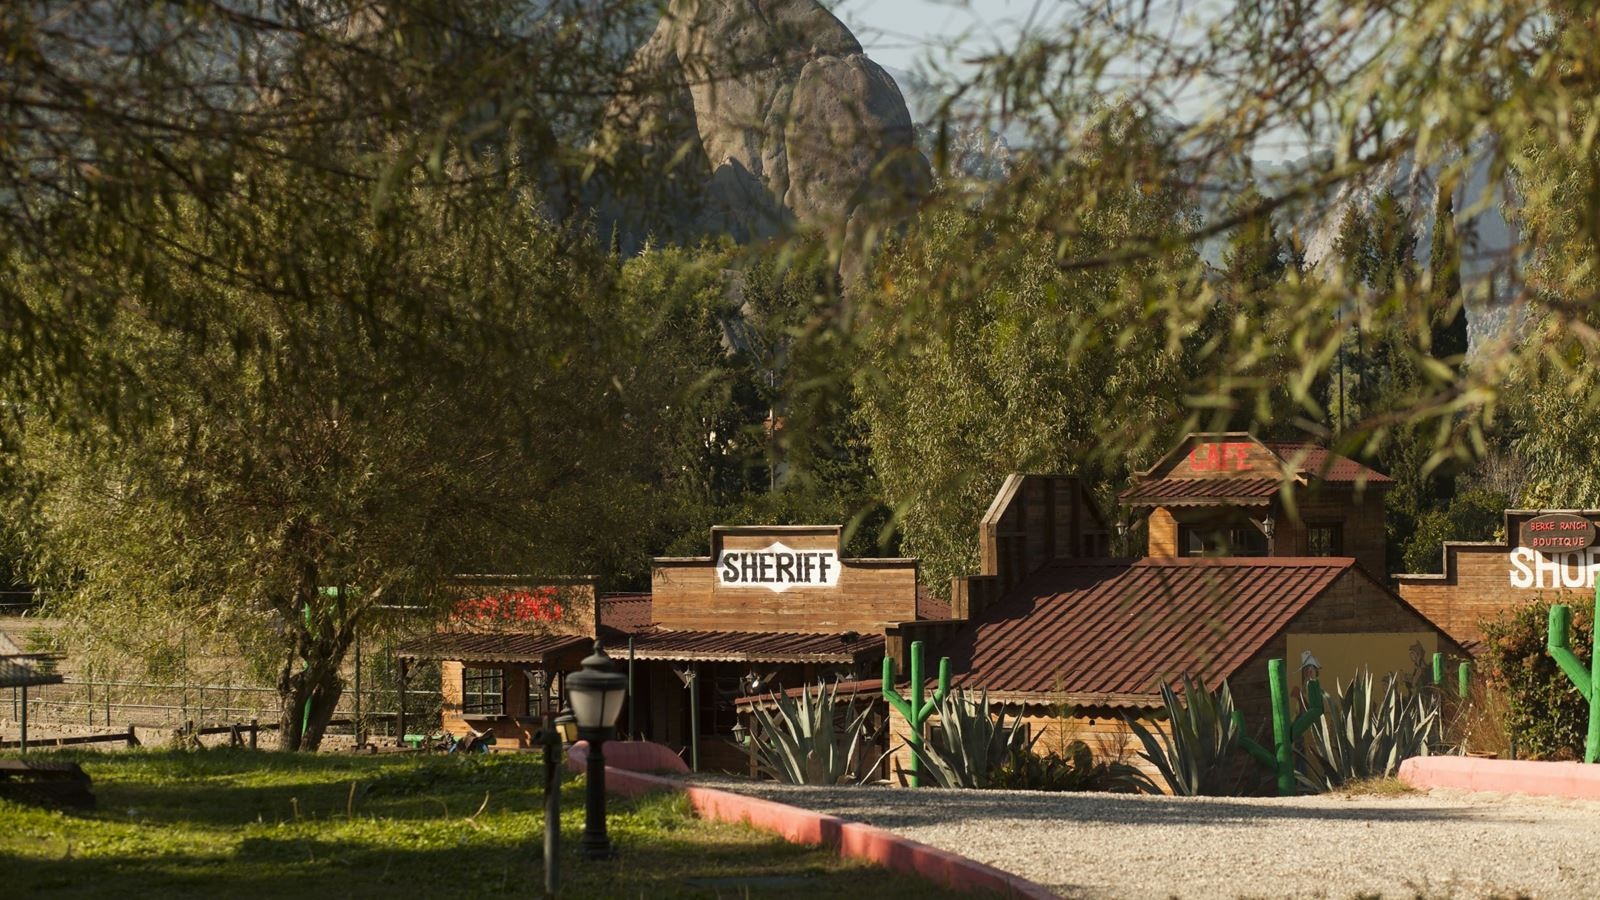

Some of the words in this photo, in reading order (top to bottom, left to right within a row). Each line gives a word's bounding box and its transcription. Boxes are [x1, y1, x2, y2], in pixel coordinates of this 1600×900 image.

[1190, 442, 1253, 471] CAFE
[1530, 521, 1555, 531] BERKE
[1560, 521, 1588, 531] RANCH
[1532, 536, 1585, 547] BOUTIQUE
[722, 552, 833, 583] SHERIFF
